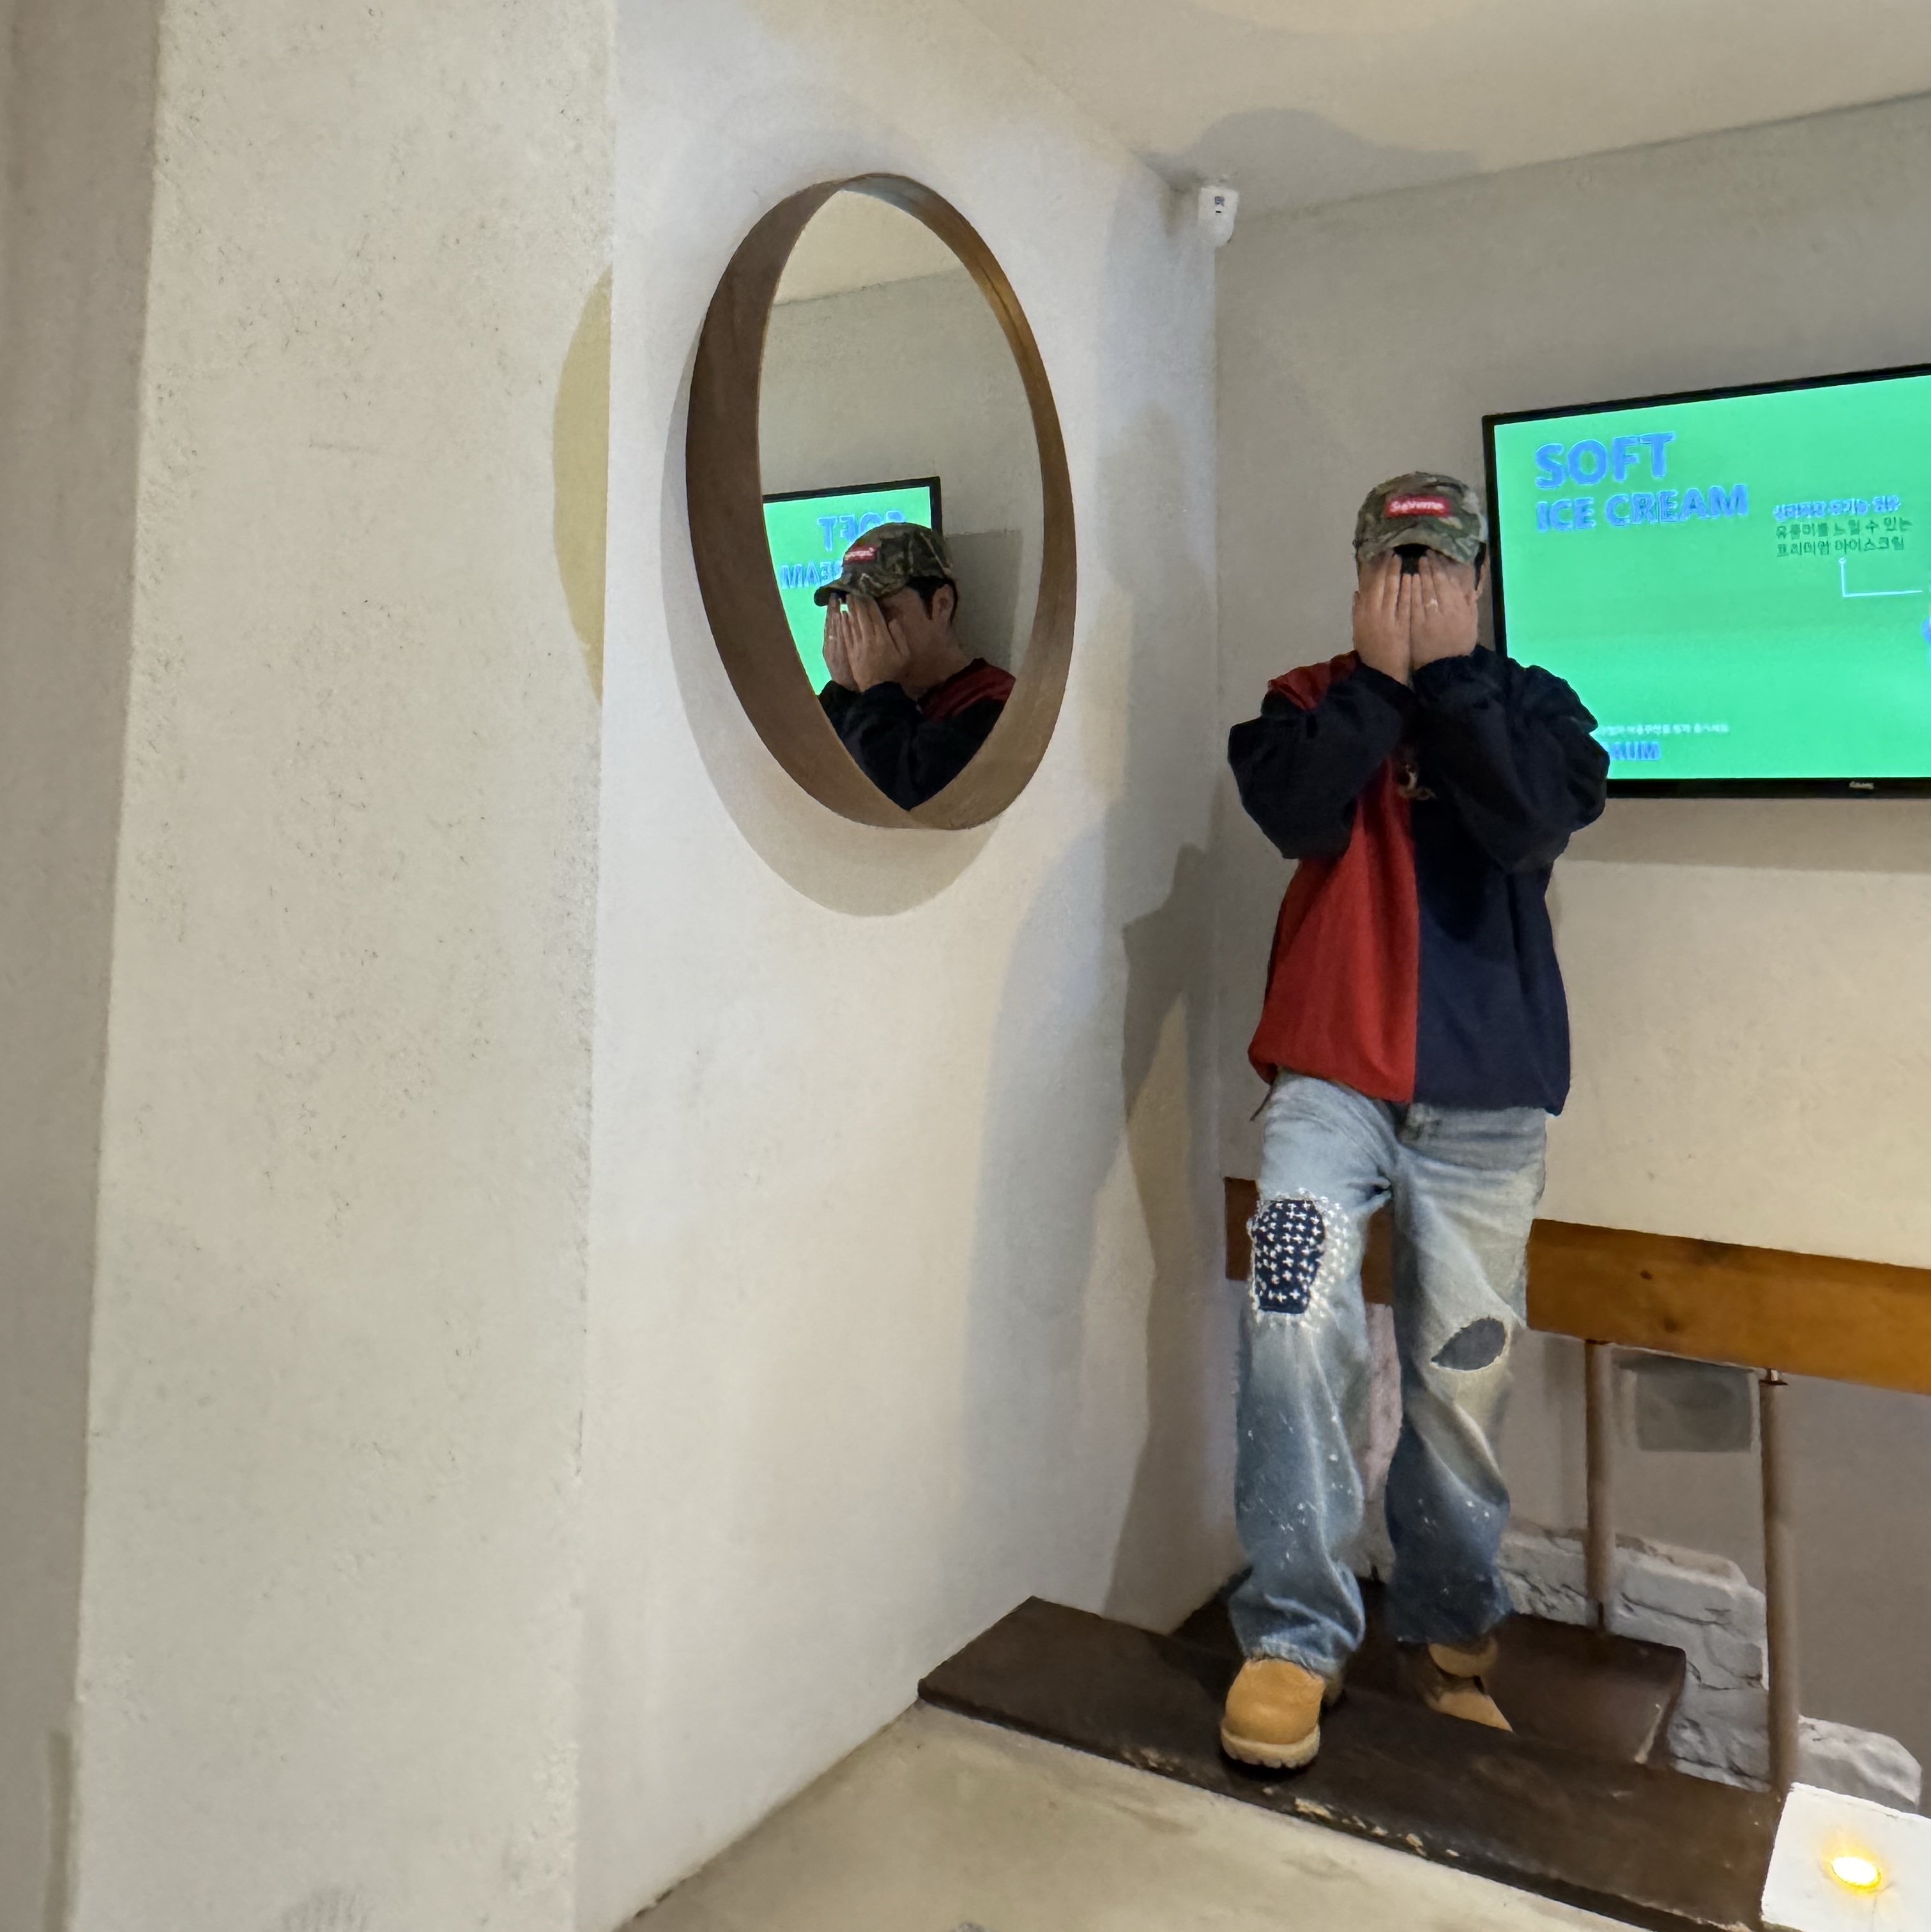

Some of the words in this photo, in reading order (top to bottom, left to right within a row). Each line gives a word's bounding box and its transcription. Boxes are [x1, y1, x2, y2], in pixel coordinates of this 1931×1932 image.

[1535, 431, 1676, 489] SOFT
[1536, 496, 1596, 532] ICE
[1605, 483, 1748, 526] CREAM
[1865, 520, 1880, 534] 수
[1776, 540, 1829, 557] 프리미엄
[1835, 536, 1904, 555] 아이스크림
